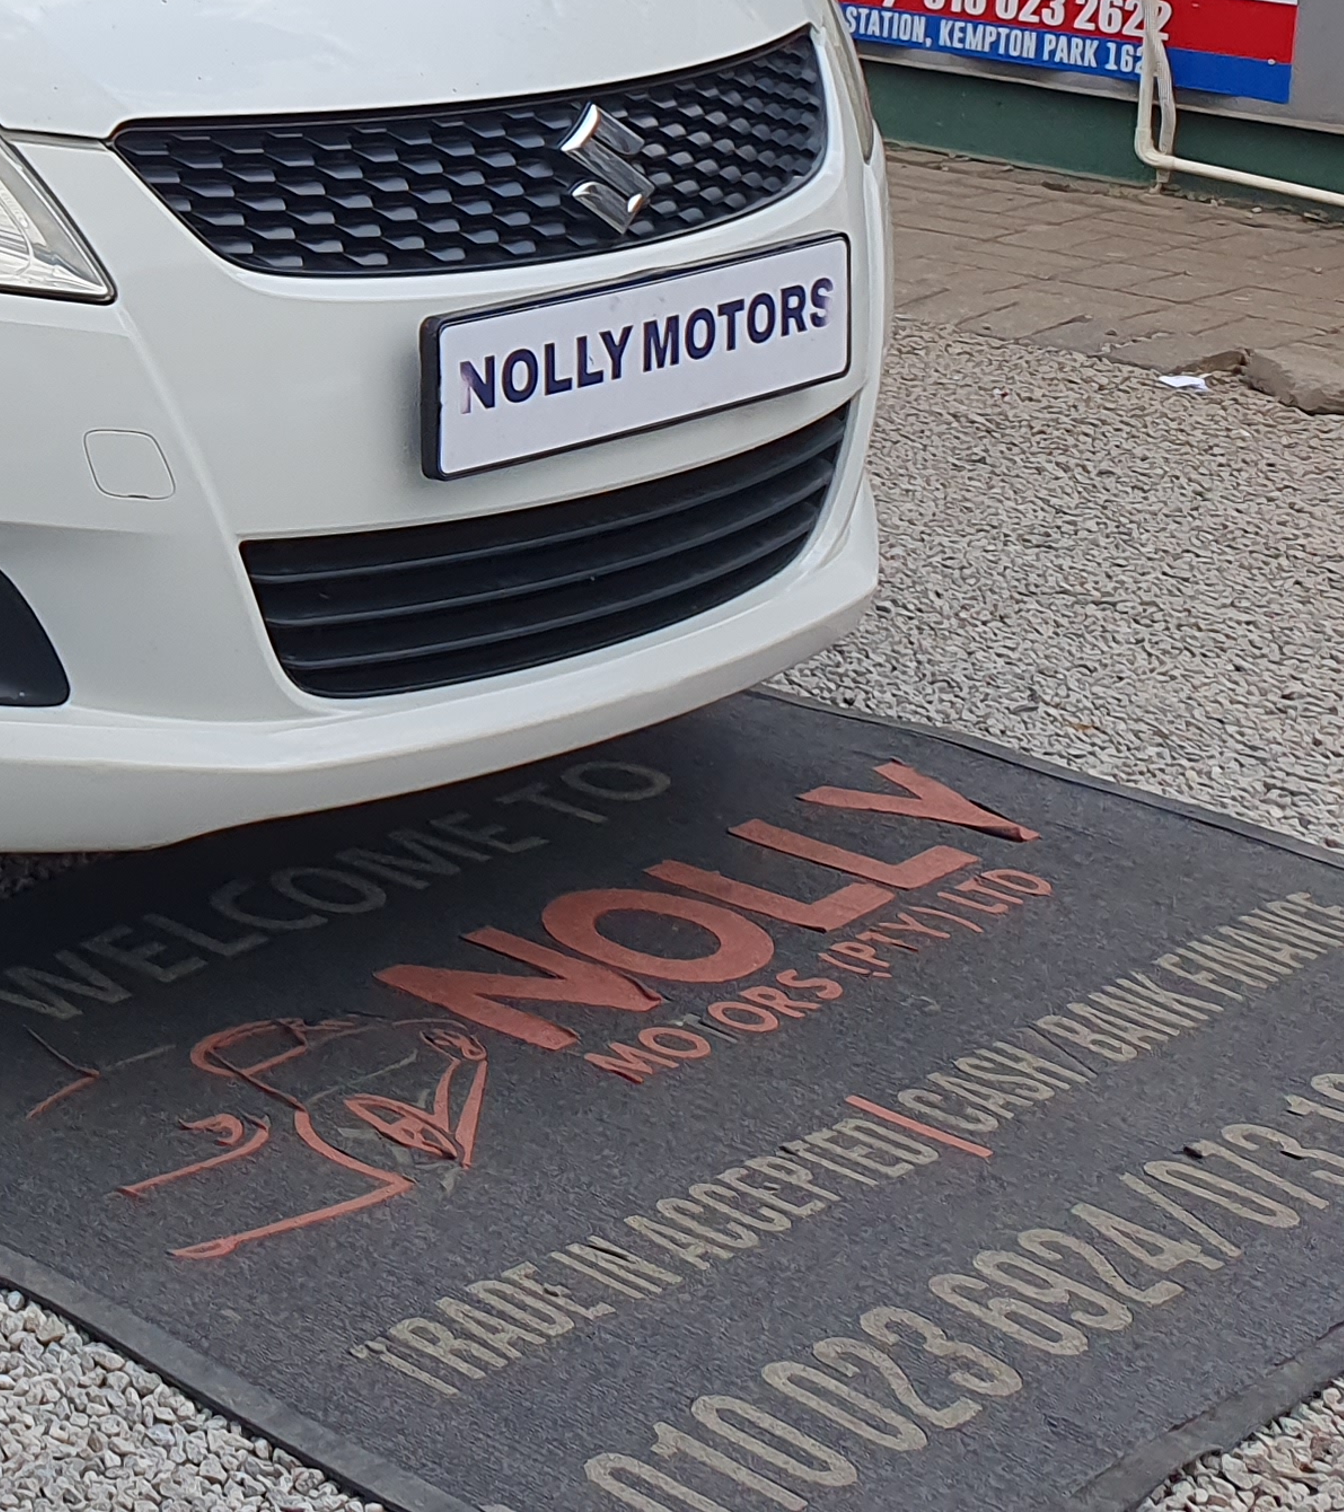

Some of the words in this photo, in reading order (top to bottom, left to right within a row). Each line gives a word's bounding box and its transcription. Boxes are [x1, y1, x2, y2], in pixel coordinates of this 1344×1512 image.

[845, 6, 932, 48] STATION,
[939, 19, 1037, 60] KEMPTON
[1043, 37, 1099, 68] PARK
[459, 325, 633, 414] NOLLY
[642, 277, 835, 373] MOTORS
[496, 760, 672, 824] TO
[373, 757, 1042, 1050] NOLLY
[583, 968, 844, 1084] MOTORS
[349, 1260, 616, 1398] TRADE
[551, 1234, 685, 1300] IN
[623, 1117, 940, 1270] ACCEPTED
[760, 1305, 1024, 1451] 023
